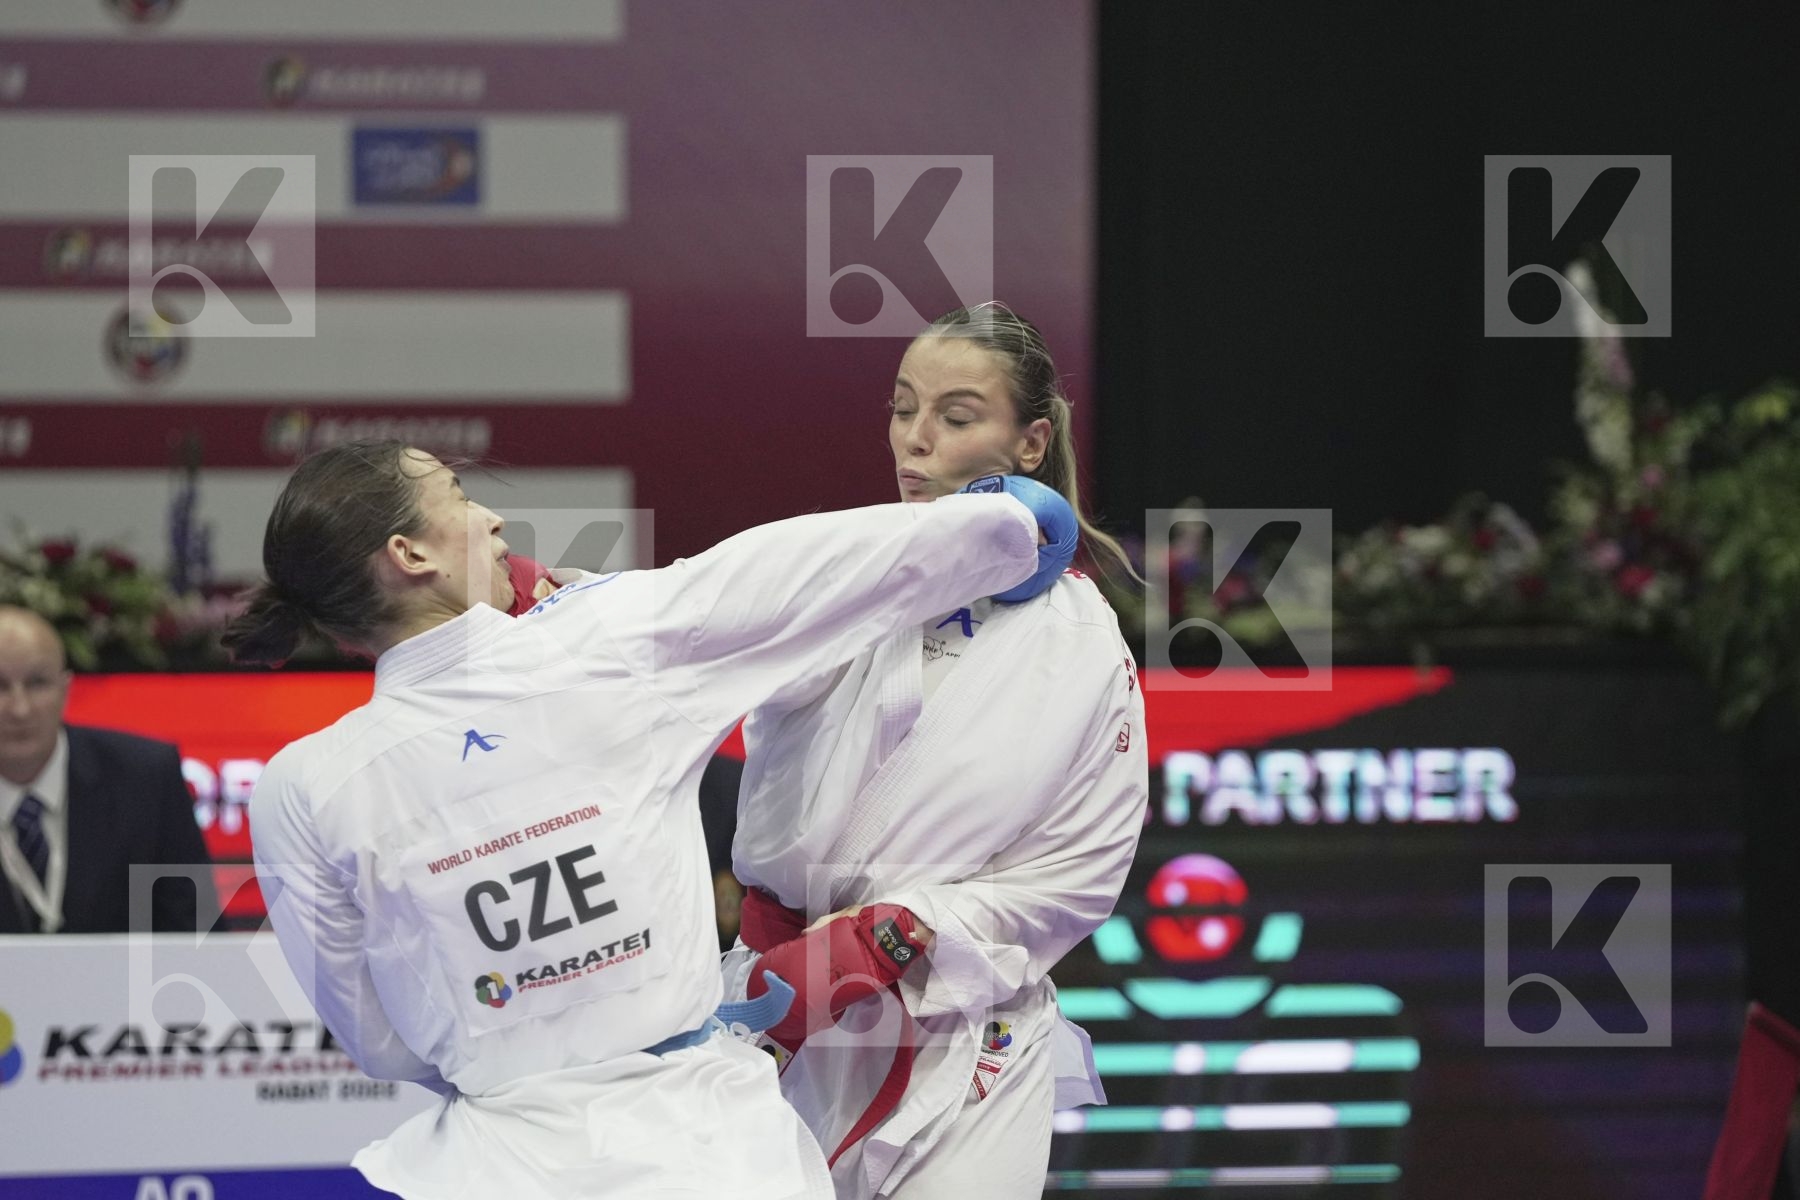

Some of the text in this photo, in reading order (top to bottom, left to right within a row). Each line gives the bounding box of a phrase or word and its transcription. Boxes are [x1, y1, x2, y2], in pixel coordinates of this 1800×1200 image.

[1163, 749, 1518, 826] PARTNER
[427, 804, 602, 875] WORLD KARATE FEDERATION
[464, 844, 619, 952] CZE
[516, 928, 651, 986] KARATE1
[518, 947, 645, 993] PREMIER LEAGUE
